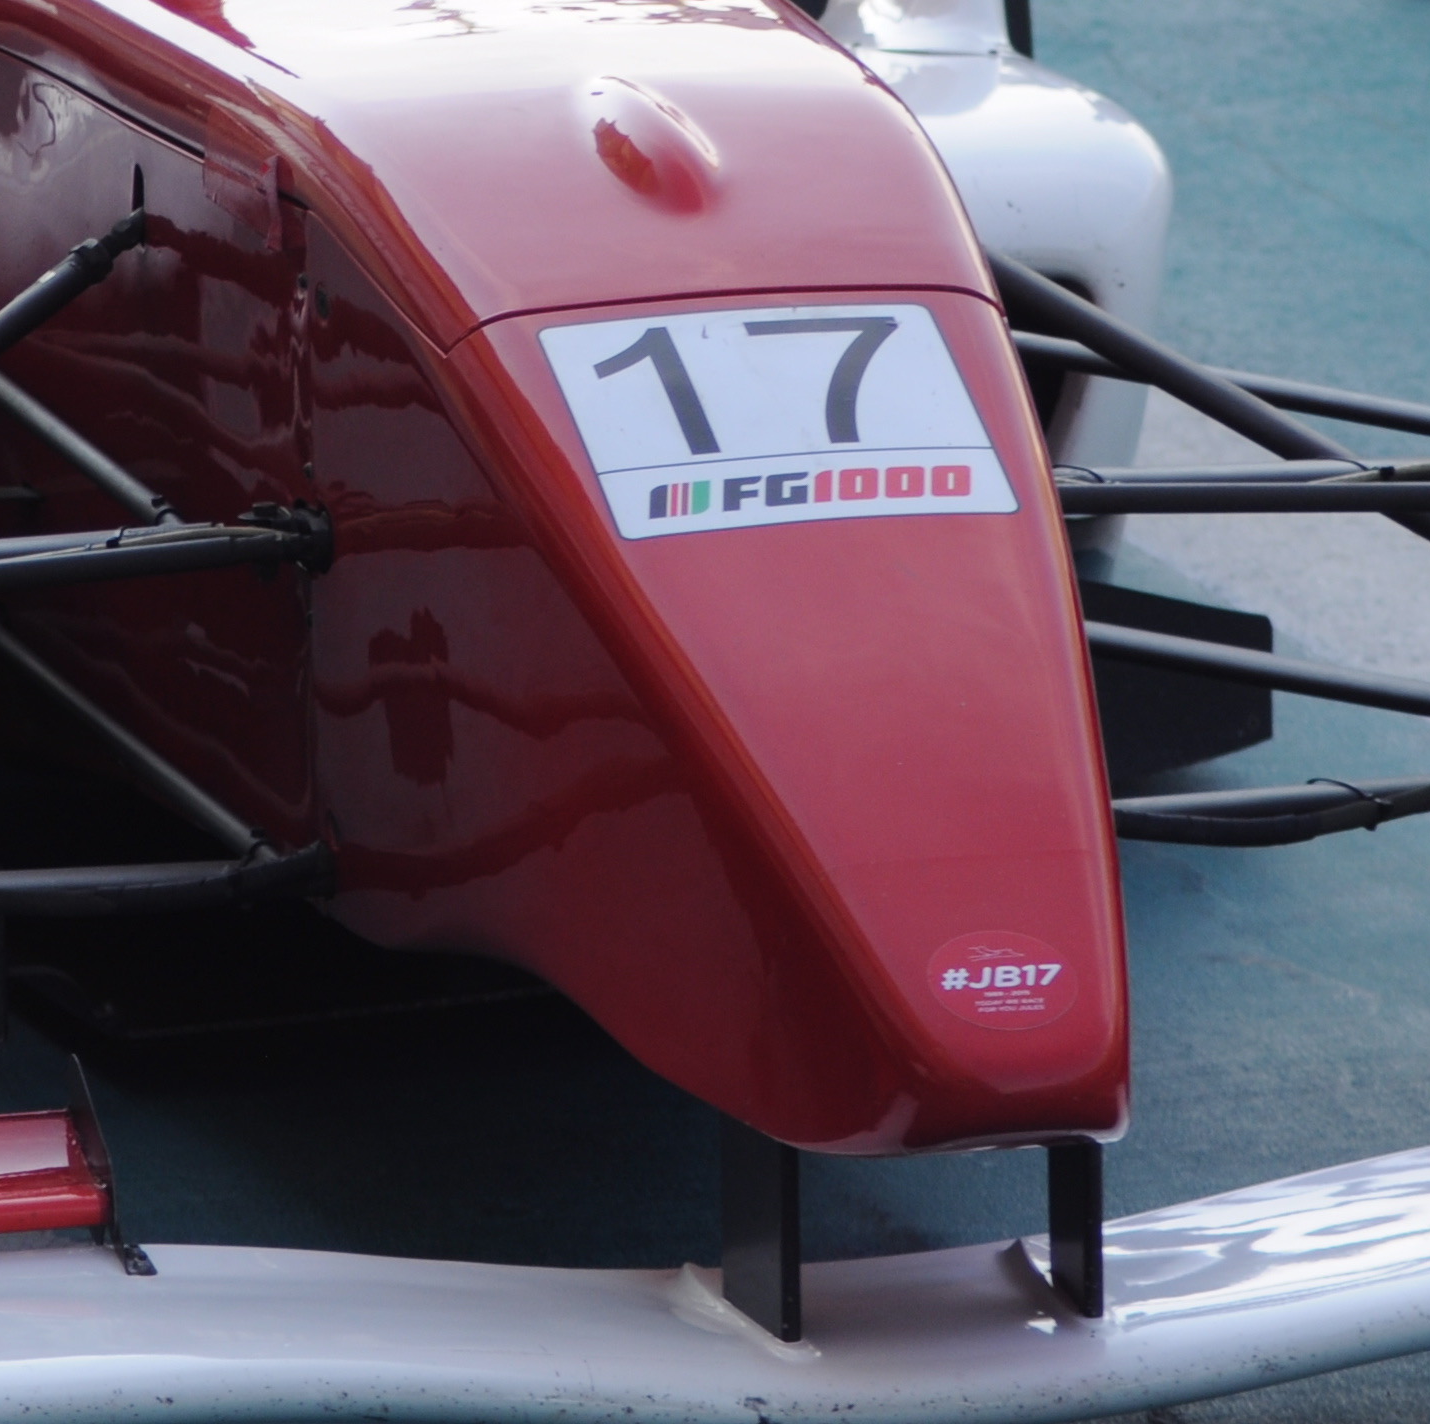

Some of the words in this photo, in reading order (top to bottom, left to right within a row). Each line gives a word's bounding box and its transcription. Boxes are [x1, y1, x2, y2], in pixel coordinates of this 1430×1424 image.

[592, 316, 899, 456] 17
[722, 464, 972, 512] FG1000
[940, 963, 1062, 991] #JB17
